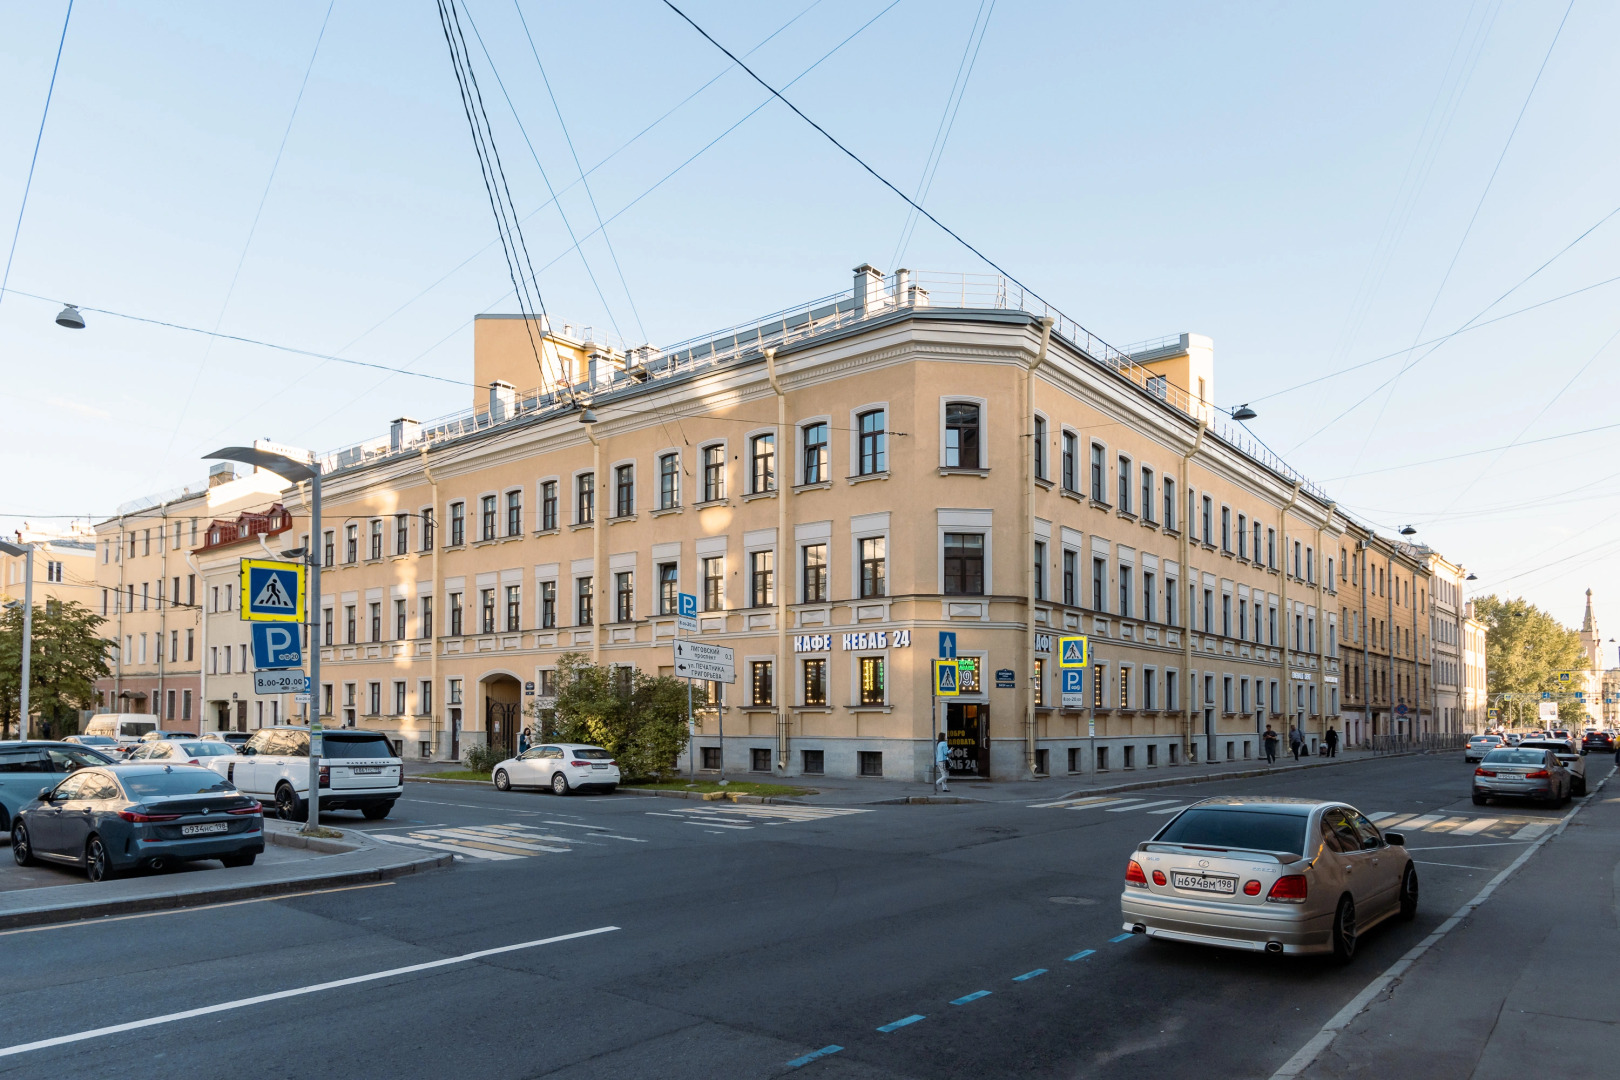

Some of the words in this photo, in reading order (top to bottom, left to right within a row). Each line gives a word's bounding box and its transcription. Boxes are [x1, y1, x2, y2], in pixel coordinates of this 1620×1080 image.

[266, 628, 292, 663] P
[794, 634, 831, 652] КАФЕ
[842, 632, 888, 651] КЕБАБ
[893, 630, 911, 648] 24
[1035, 634, 1052, 652] АФЕ
[690, 645, 720, 655] ЛИГОВСКИЙ
[691, 669, 722, 679] ГРИГОРЬЕВА
[695, 662, 725, 672] ПЕЧАТНИКА
[1177, 876, 1216, 890] Н694ВМ
[1217, 879, 1232, 889] 198
